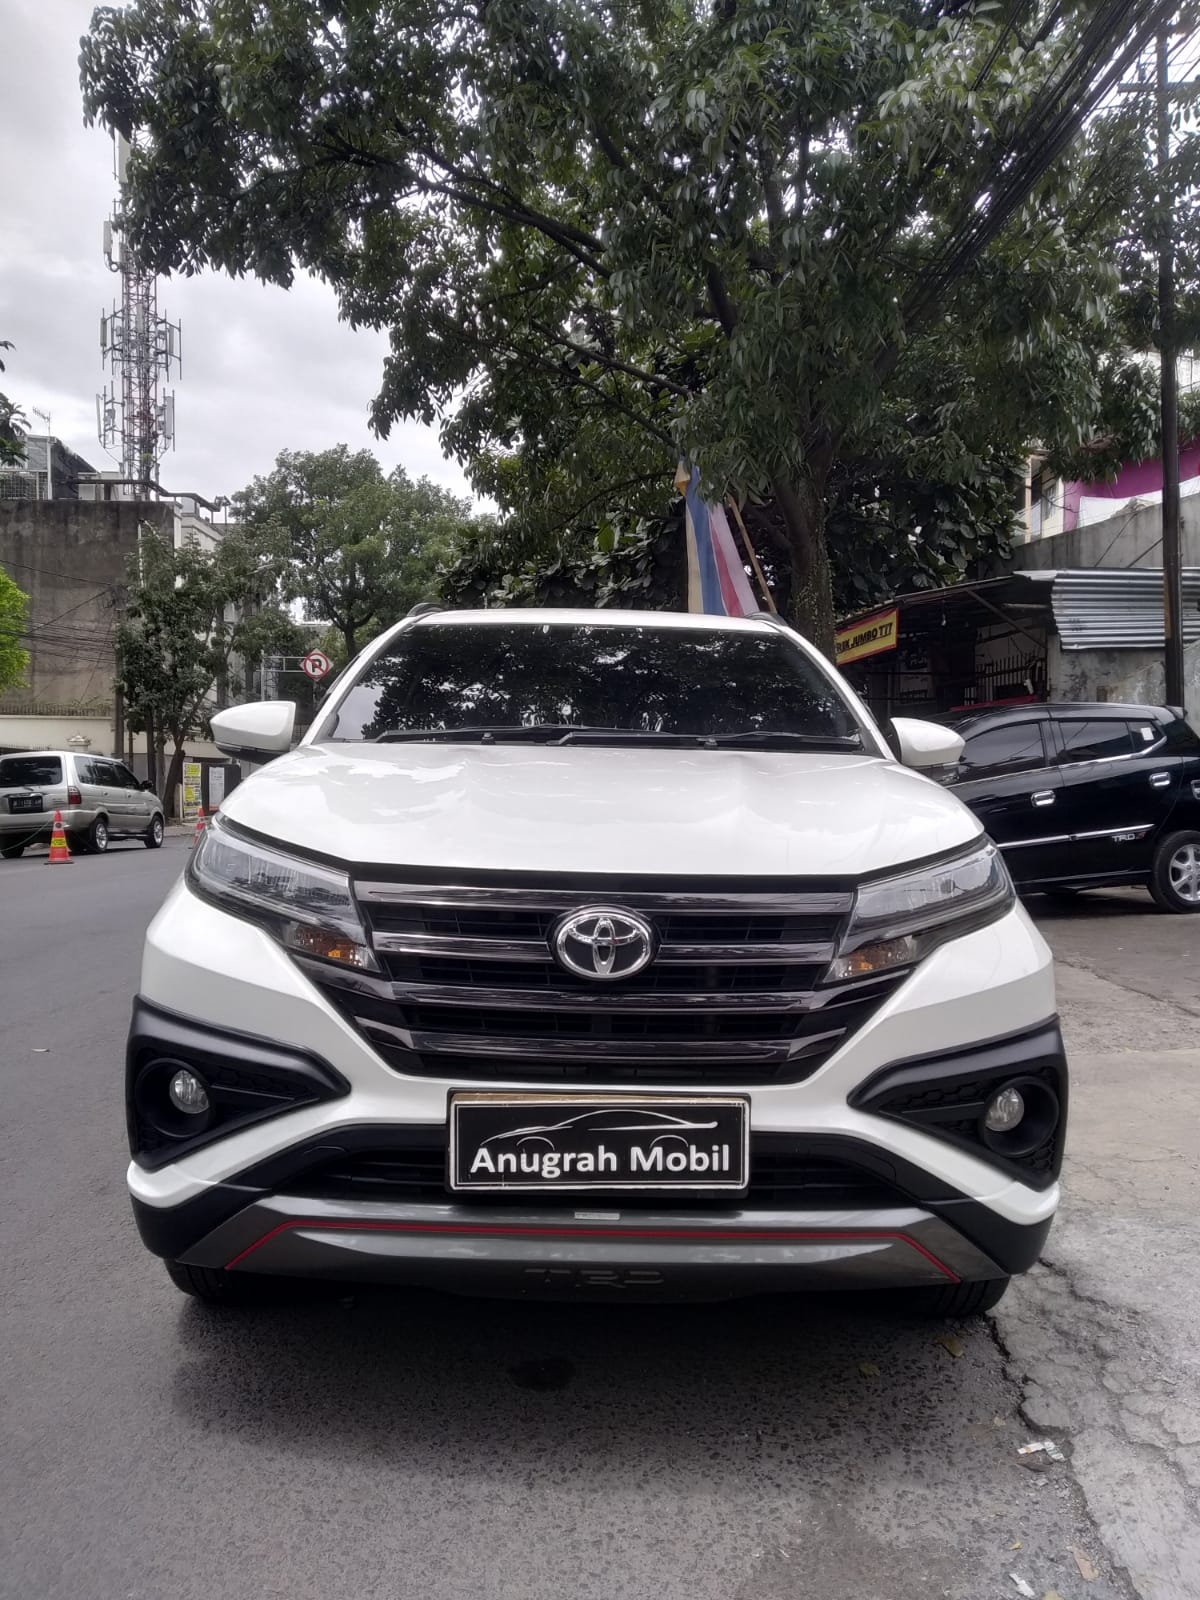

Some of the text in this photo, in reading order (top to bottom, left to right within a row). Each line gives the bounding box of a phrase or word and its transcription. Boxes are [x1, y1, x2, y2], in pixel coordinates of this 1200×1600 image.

[851, 628, 878, 648] JUMBO
[470, 1144, 730, 1179] Anugrah Mobil
